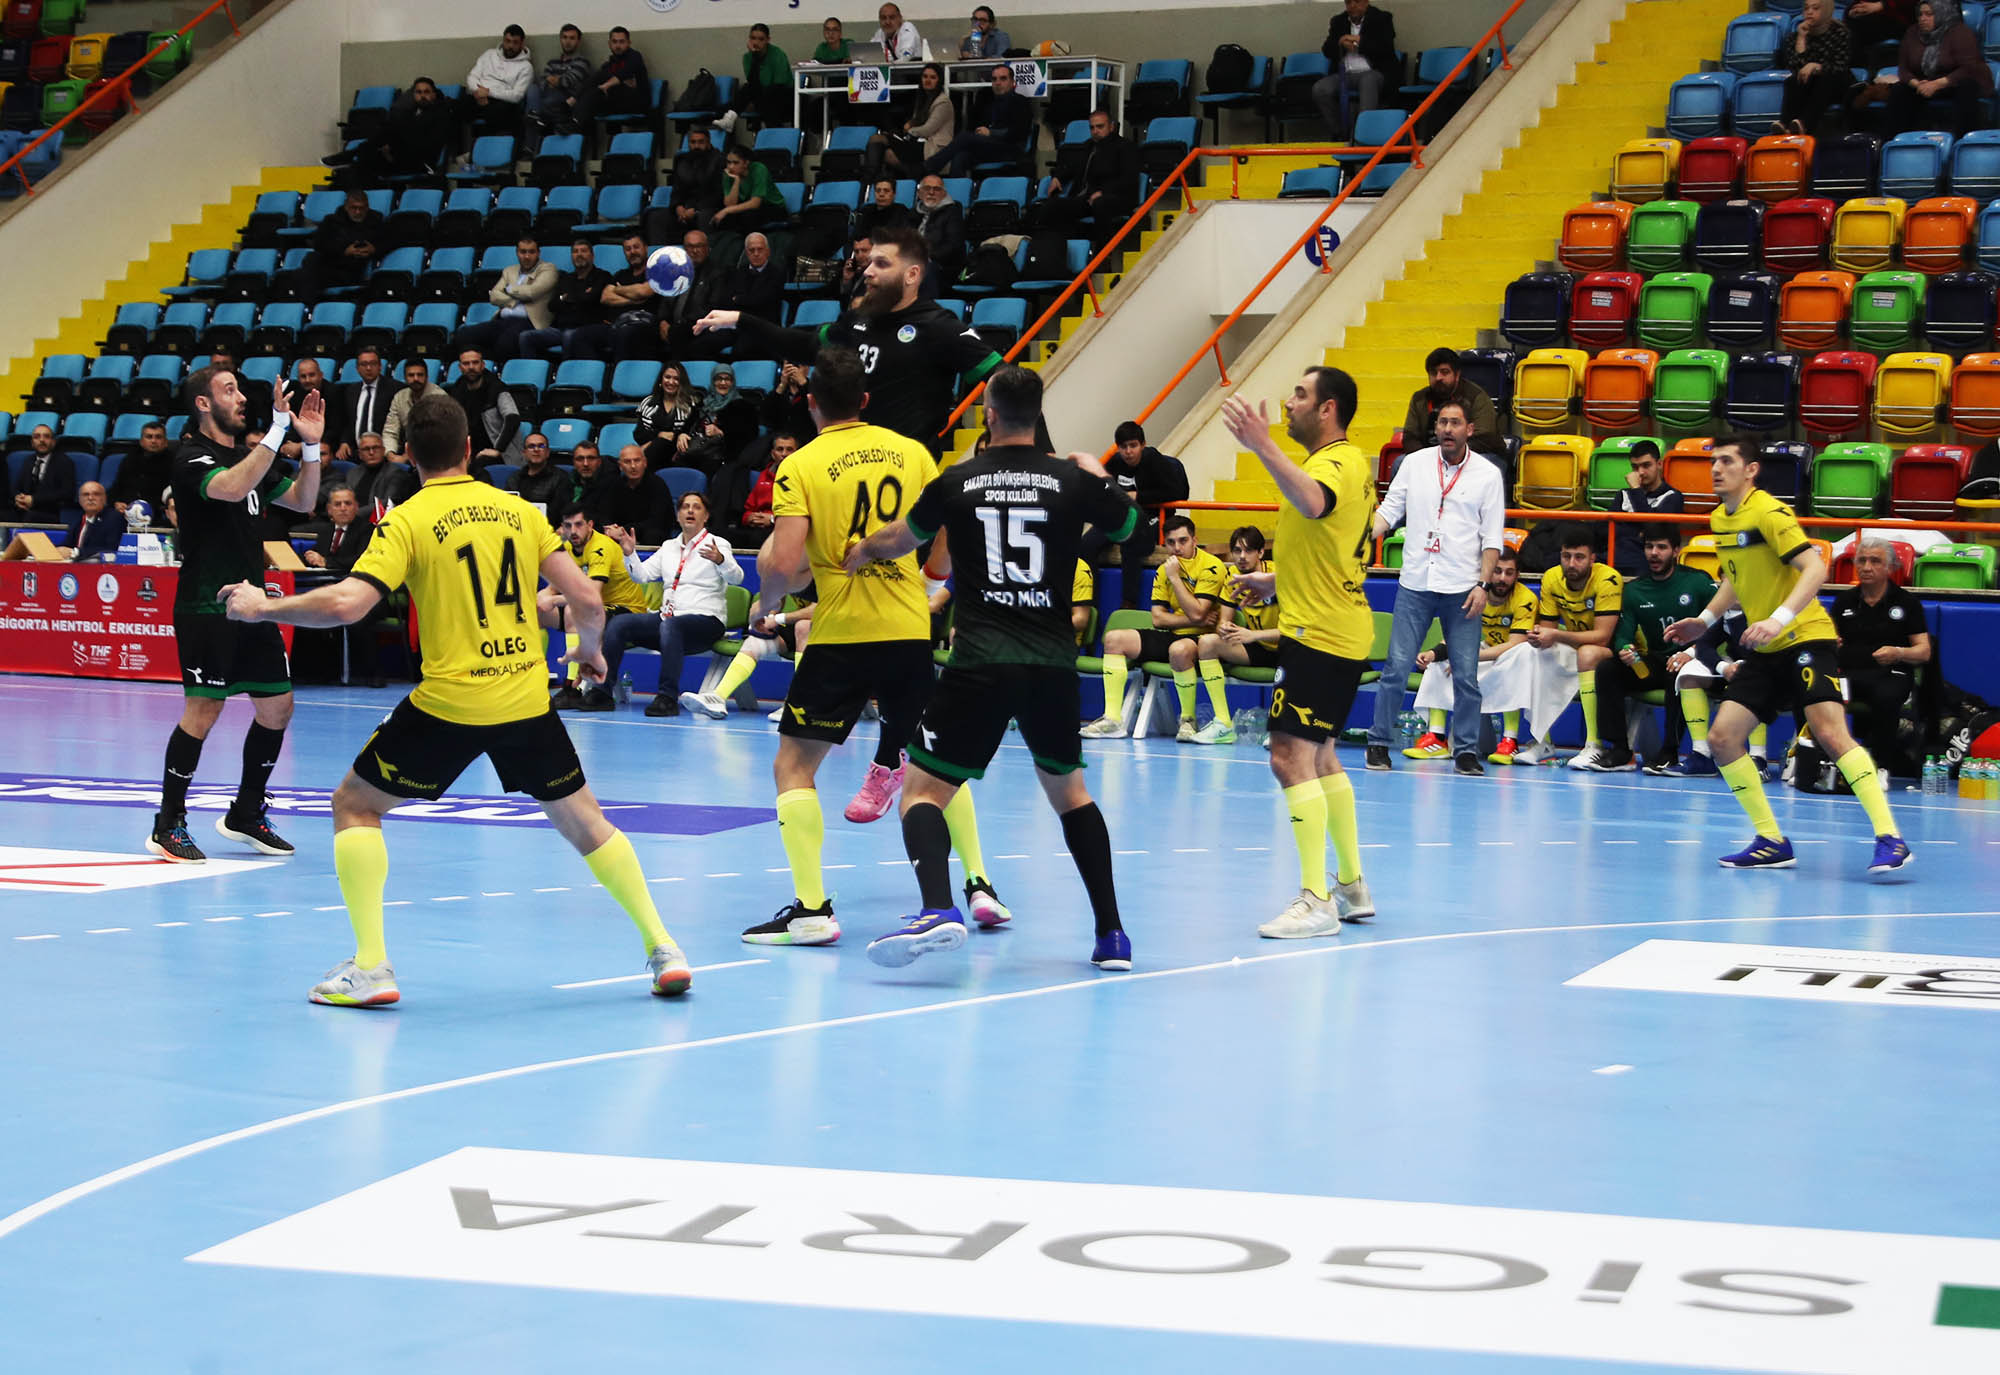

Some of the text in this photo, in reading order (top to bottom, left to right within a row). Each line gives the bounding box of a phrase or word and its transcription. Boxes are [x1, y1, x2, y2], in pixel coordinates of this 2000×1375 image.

[860, 70, 879, 80] BASIN
[1015, 64, 1036, 74] BASIN
[1015, 75, 1035, 85] PRESS
[859, 81, 878, 91] PRESS
[1315, 233, 1331, 257] E
[827, 445, 905, 482] BEYKOZ BELEDİYESİ
[962, 473, 993, 493] SAKARYA
[984, 488, 1039, 502] SPOR KULÜBÜ
[431, 503, 523, 545] BEYKOZ BELEDİYESİ
[974, 506, 1048, 584] 15
[455, 536, 528, 629] 14
[0, 615, 176, 638] SİGORTA HENTBOL ERKEKLER
[89, 644, 112, 657] THF
[480, 636, 527, 658] OLEG
[1801, 667, 1815, 692] 9
[448, 1185, 1871, 1317] SİGORTA
